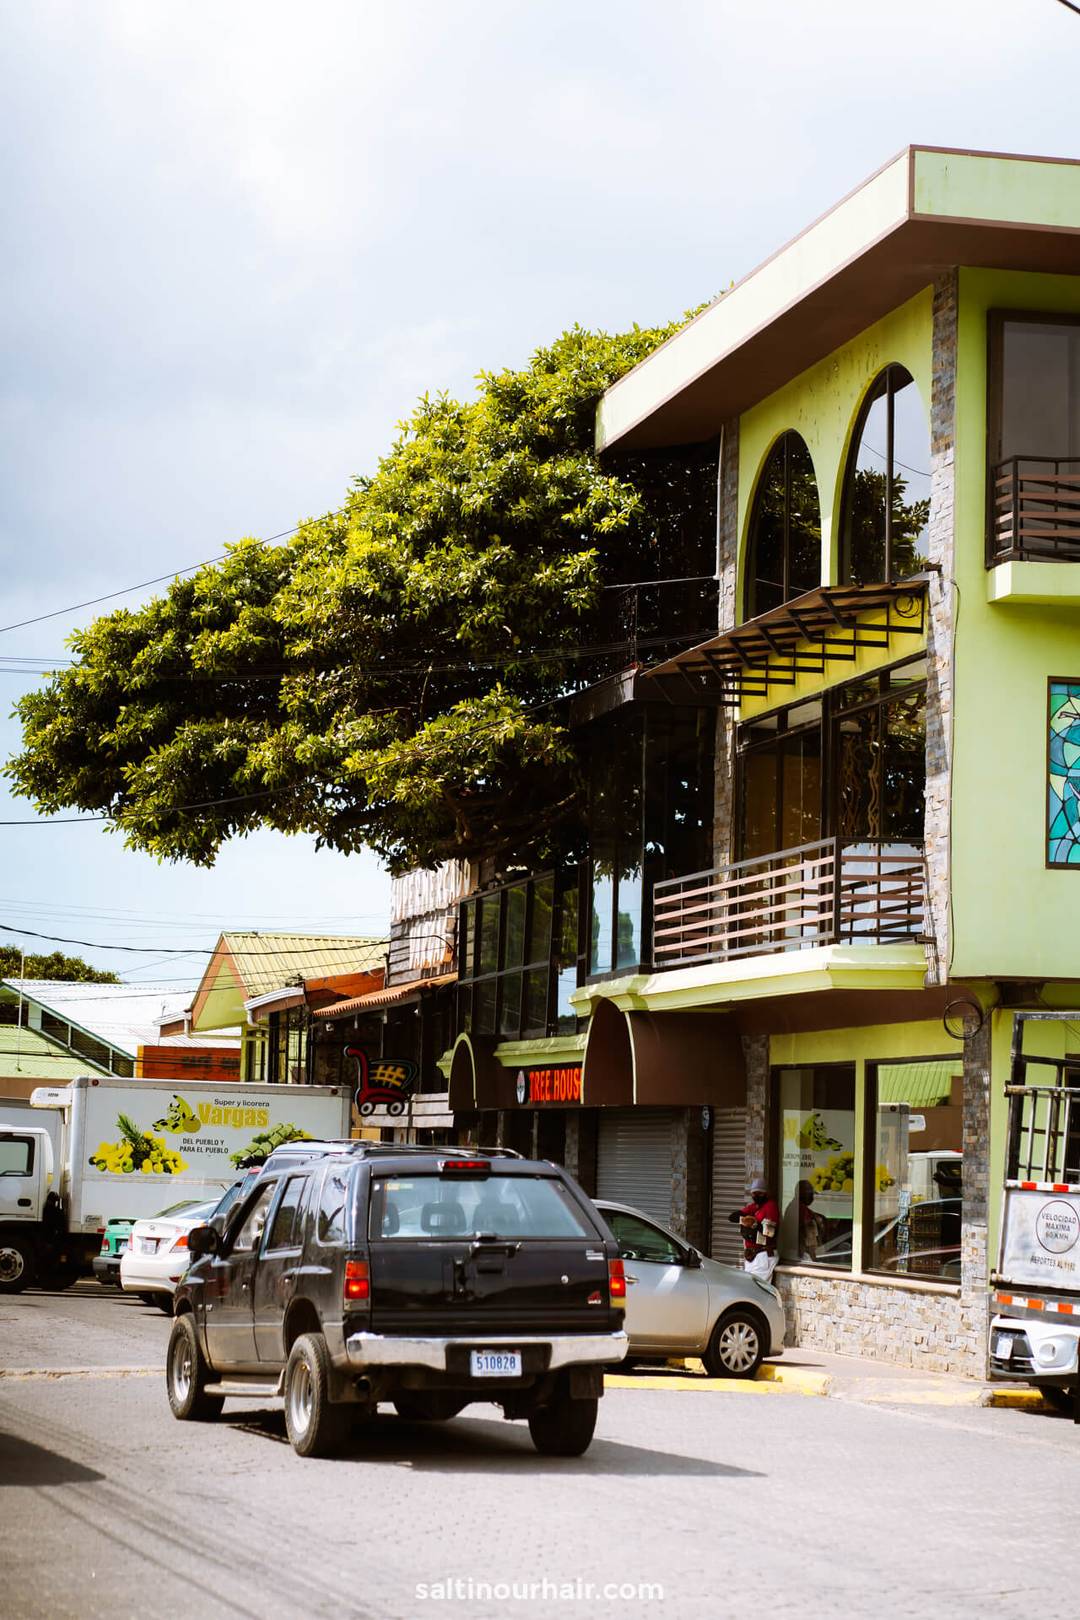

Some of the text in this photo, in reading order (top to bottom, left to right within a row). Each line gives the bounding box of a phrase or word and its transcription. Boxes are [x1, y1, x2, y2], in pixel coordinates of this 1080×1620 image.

[529, 1068, 581, 1101] TREE HOUS
[214, 1099, 235, 1107] Super
[198, 1103, 269, 1129] Vargas
[182, 1138, 194, 1146] DEL
[206, 1146, 229, 1154] PUEBLO
[1041, 1212, 1077, 1224] VELOCIDAD
[476, 1355, 516, 1370] 510828
